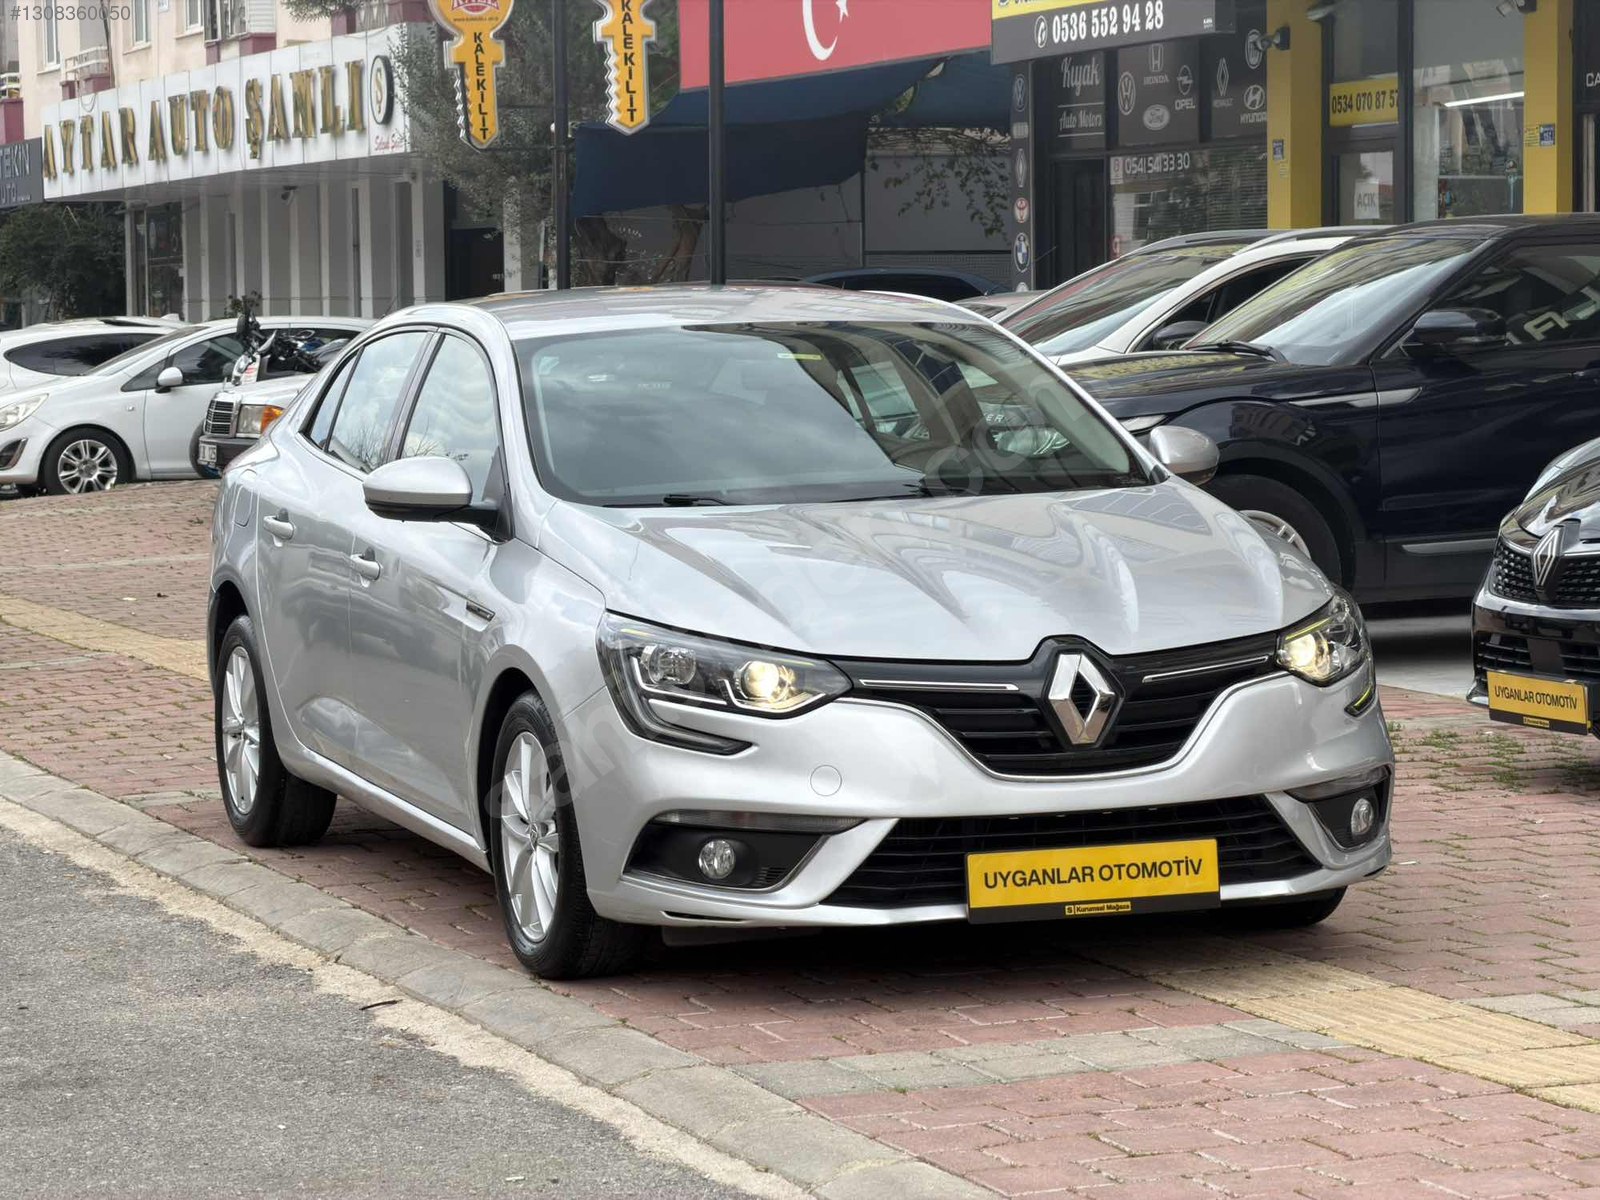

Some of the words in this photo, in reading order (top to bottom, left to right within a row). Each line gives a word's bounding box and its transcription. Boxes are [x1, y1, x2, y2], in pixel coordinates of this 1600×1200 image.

[1052, 12, 1087, 44] 0536
[1091, 7, 1118, 38] 552
[1122, 3, 1141, 33] 94
[1145, 0, 1164, 30] 28
[1174, 98, 1196, 111] OPEL
[1331, 95, 1354, 114] 0534
[1356, 91, 1373, 112] 070
[1375, 90, 1387, 110] 87
[43, 107, 140, 180] AYTAR
[148, 86, 236, 162] AUTO
[245, 59, 368, 160] ŞANLI
[1494, 685, 1535, 704] UYGANLAR
[1535, 692, 1578, 710] OTOMOTİV
[984, 866, 1095, 889] UYGANLAR
[1099, 855, 1203, 881] OTOMOTİV
[1076, 901, 1105, 913] Kurumsal
